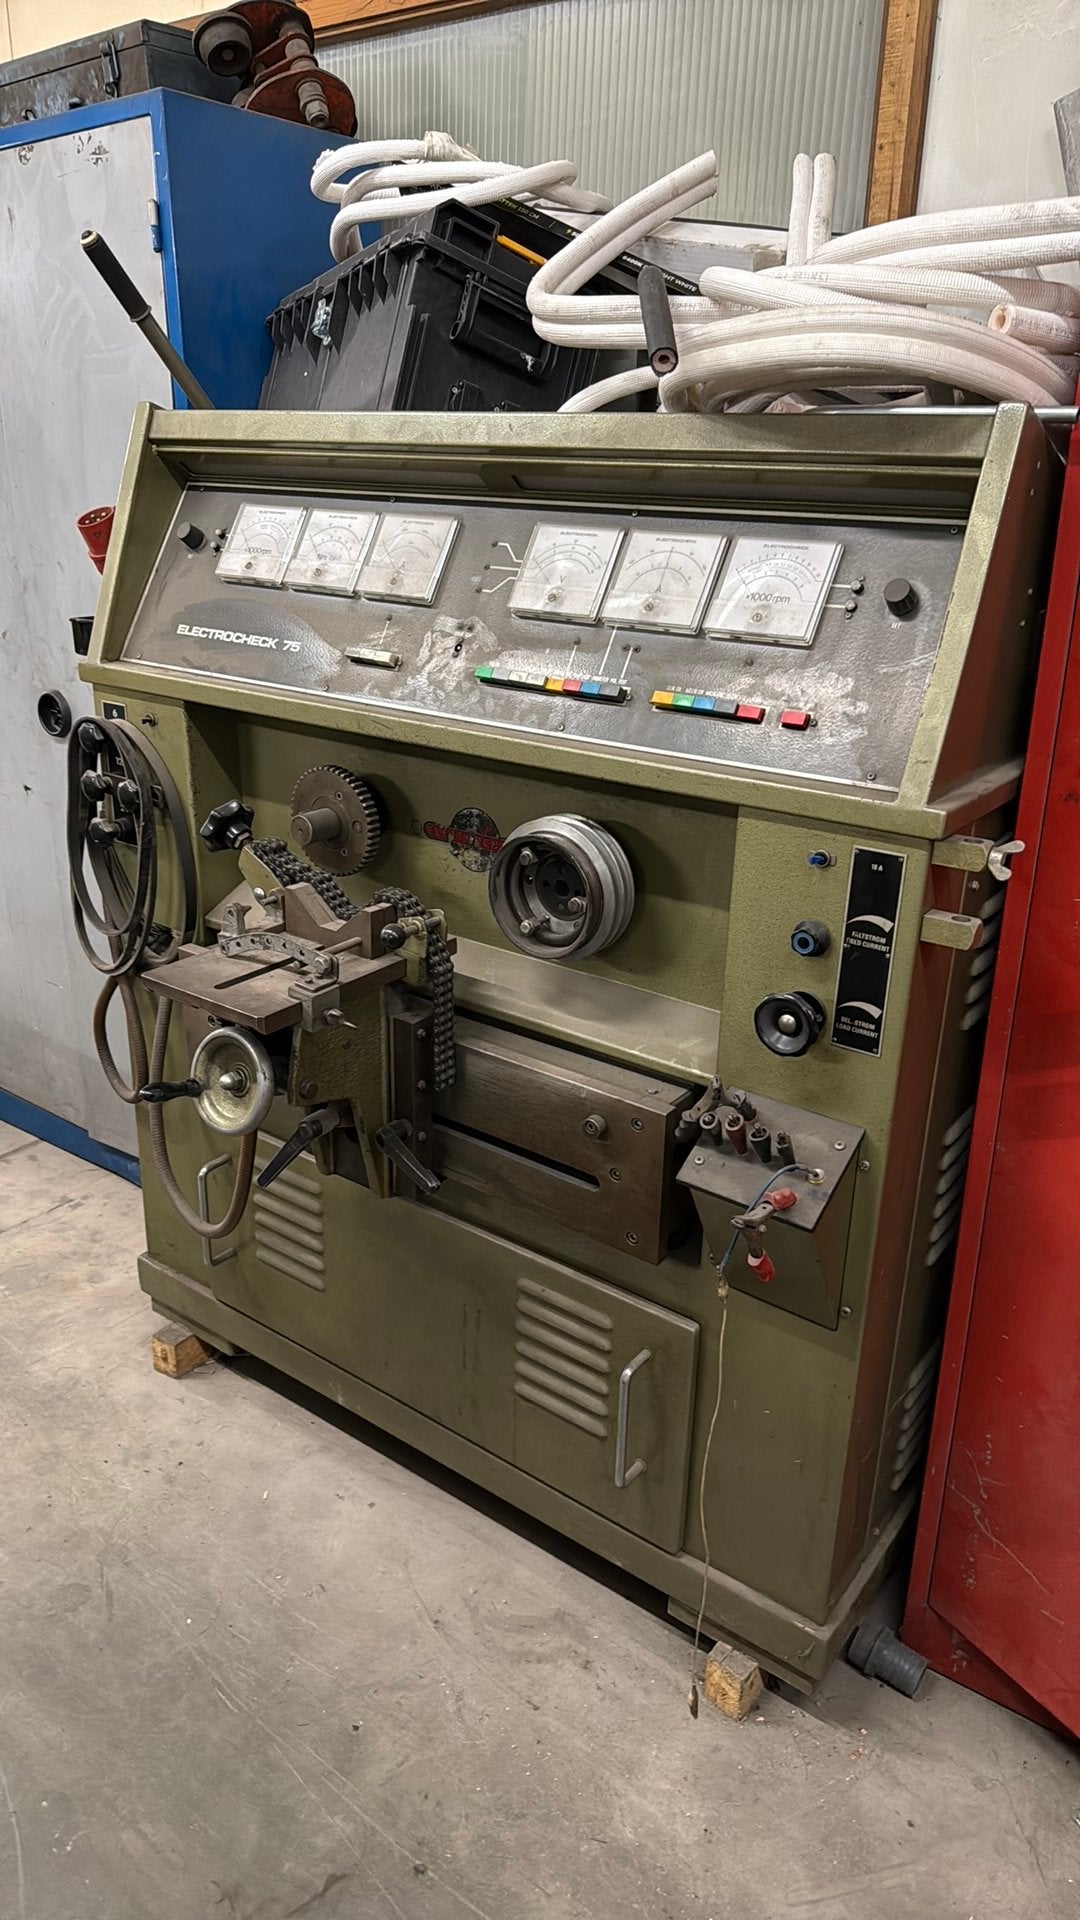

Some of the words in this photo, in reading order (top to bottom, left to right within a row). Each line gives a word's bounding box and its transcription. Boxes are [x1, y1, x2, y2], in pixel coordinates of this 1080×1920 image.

[675, 278, 697, 292] WHITE
[176, 624, 279, 649] ELECTROCHECK
[282, 640, 302, 652] 75
[112, 709, 118, 717] 6
[877, 864, 883, 872] A
[862, 941, 890, 953] CURRENT
[836, 1022, 851, 1032] LOAD
[851, 1026, 879, 1039] CURRENT
